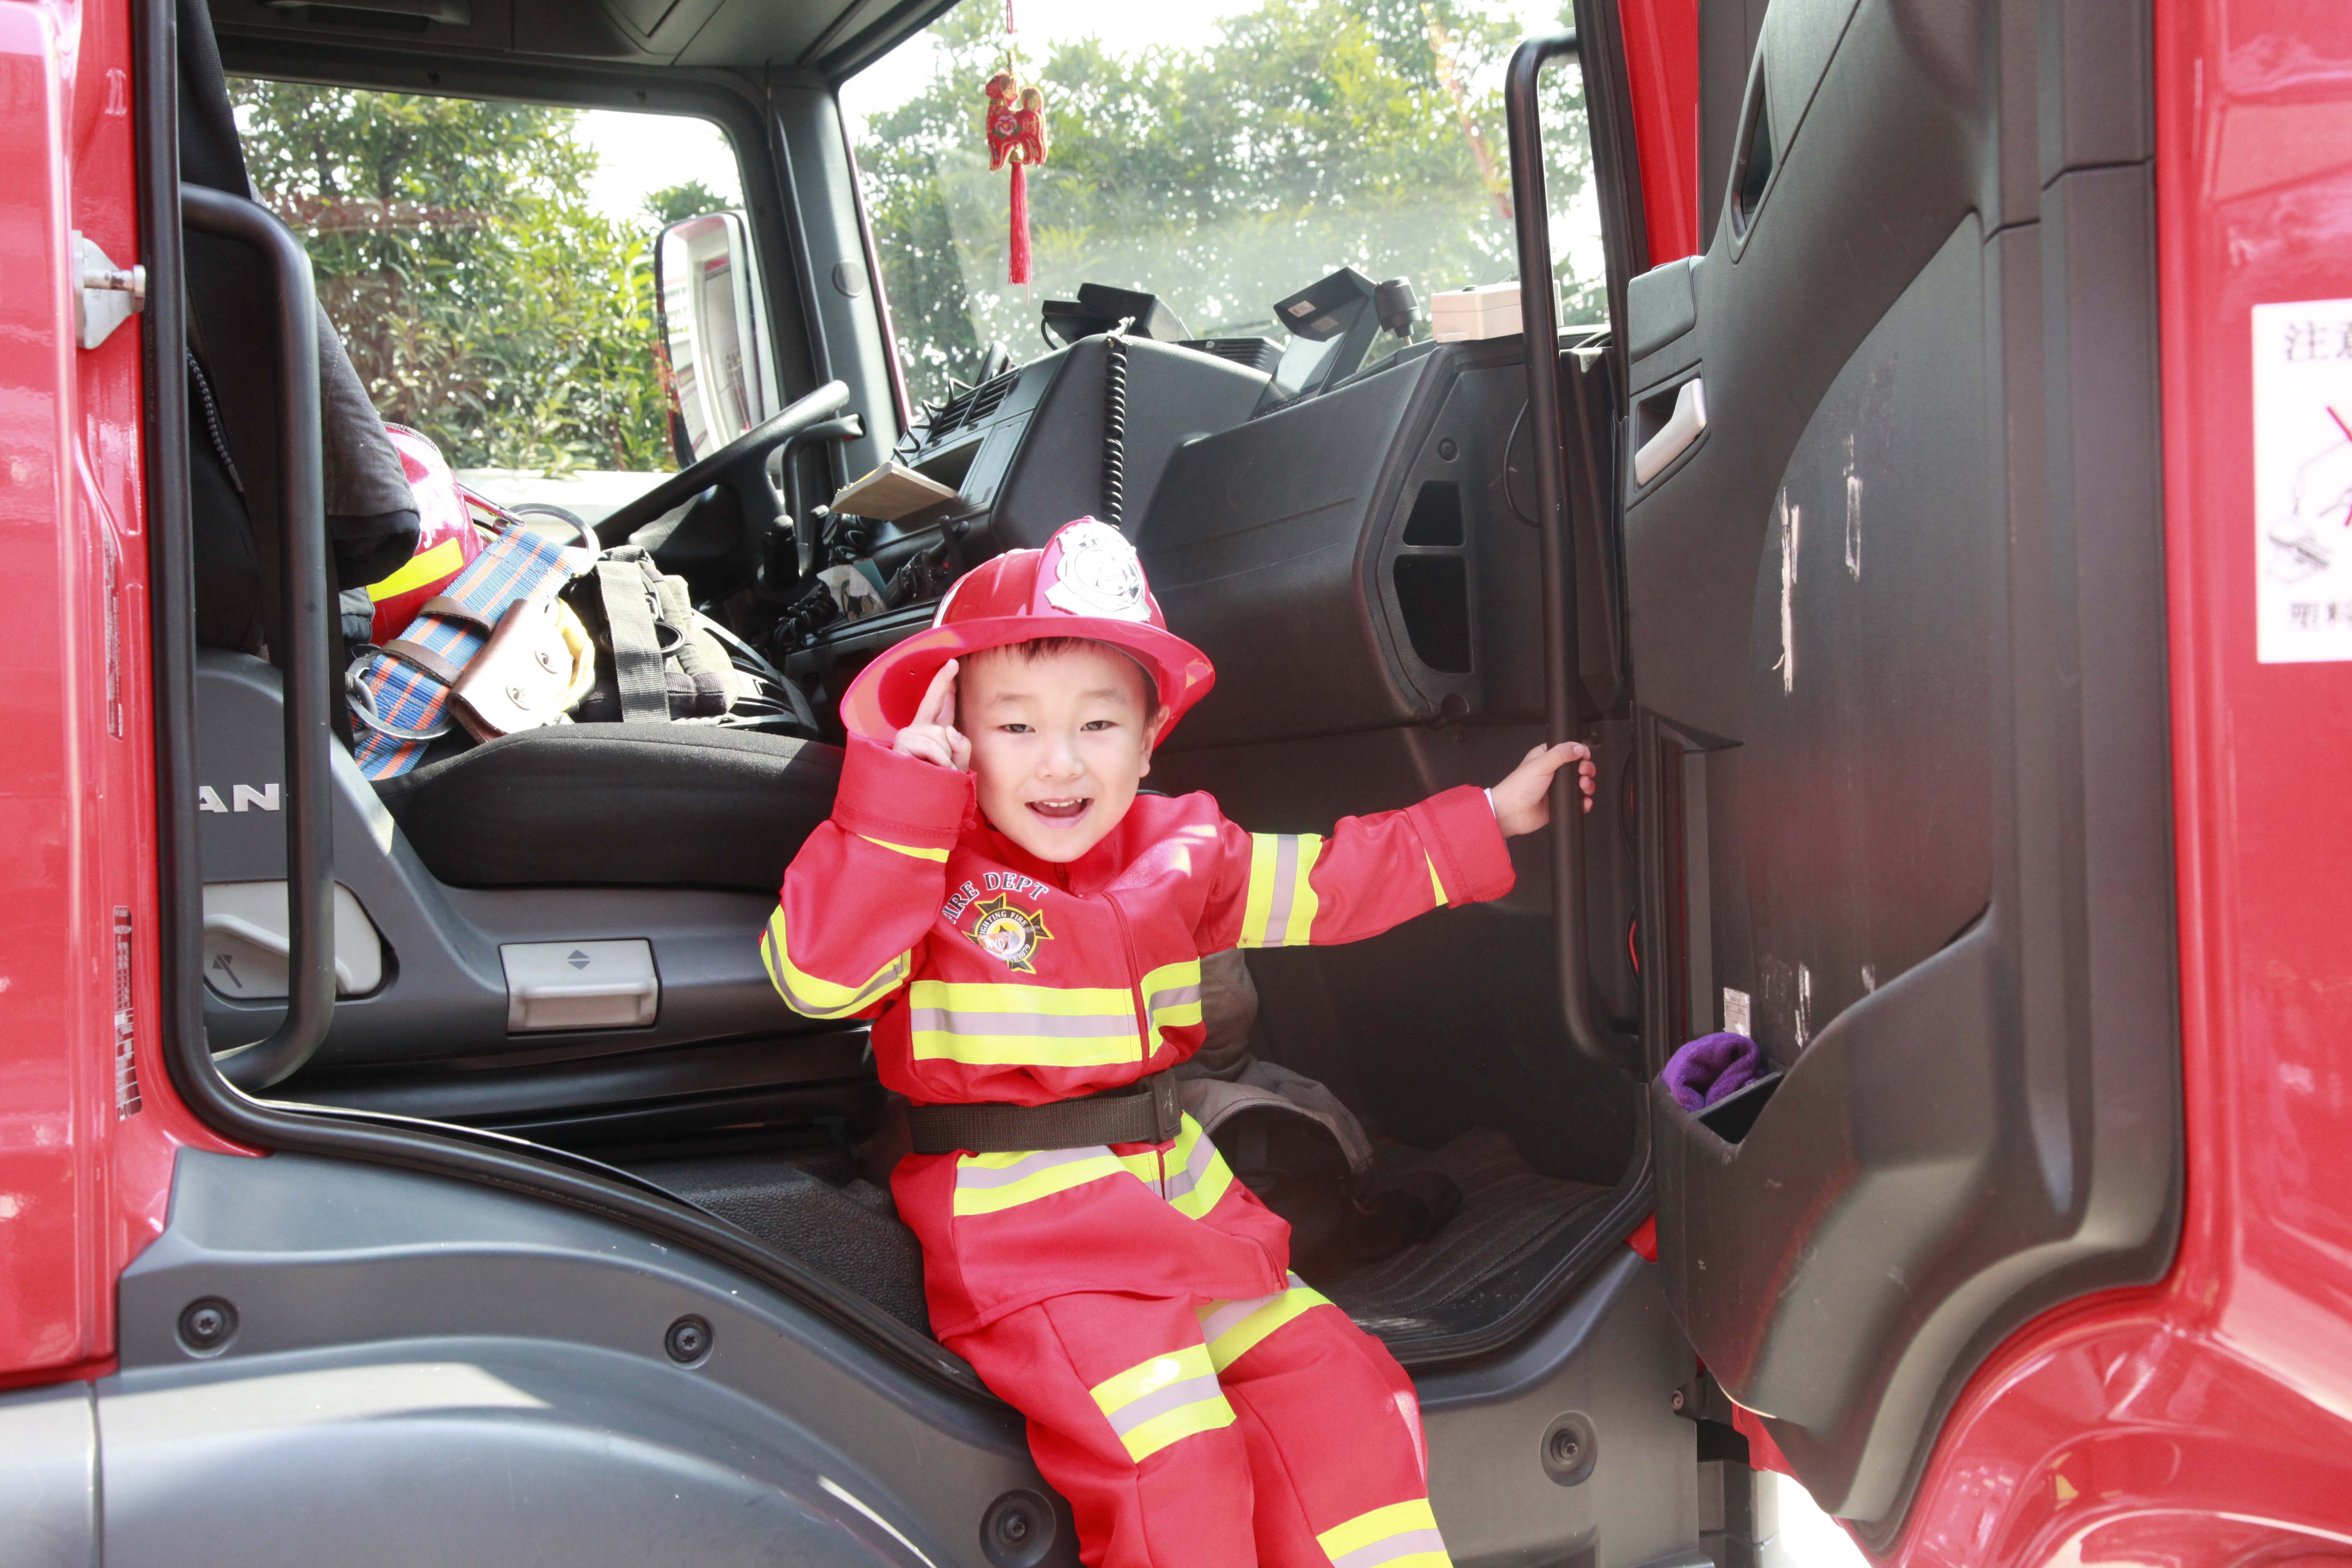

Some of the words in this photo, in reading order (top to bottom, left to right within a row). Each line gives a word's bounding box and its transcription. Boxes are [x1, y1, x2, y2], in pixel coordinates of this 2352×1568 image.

[983, 872, 1049, 900] DEPT
[979, 911, 1006, 935] IGHTING
[1010, 912, 1028, 926] FIRE
